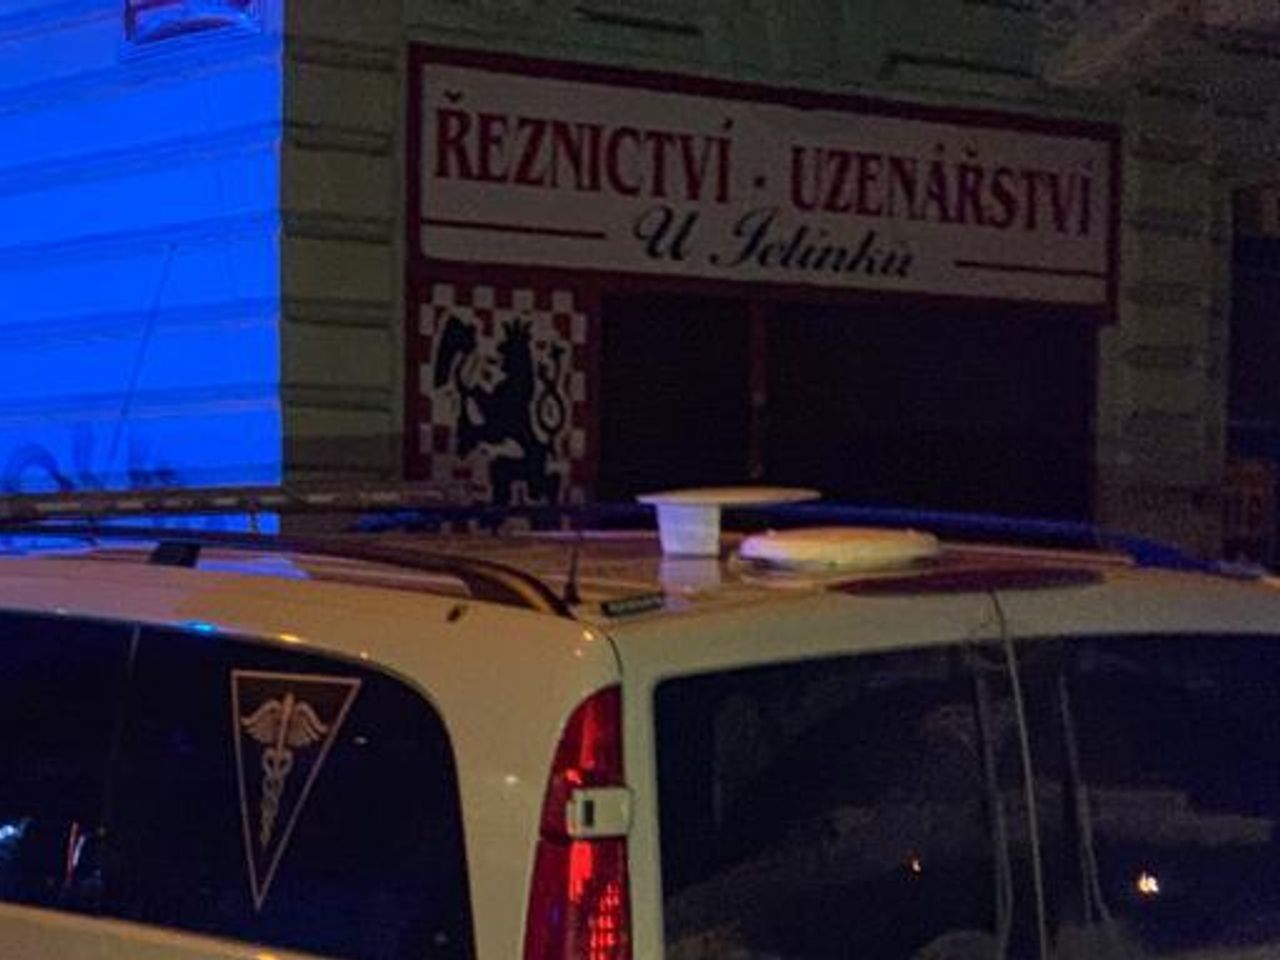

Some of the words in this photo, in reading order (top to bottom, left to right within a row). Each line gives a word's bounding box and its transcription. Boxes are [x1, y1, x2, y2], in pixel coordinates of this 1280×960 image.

[433, 90, 733, 204] ŘEZNICTVÍ
[789, 138, 1094, 237] UZENÁŘSTVÍ
[634, 205, 702, 260] U
